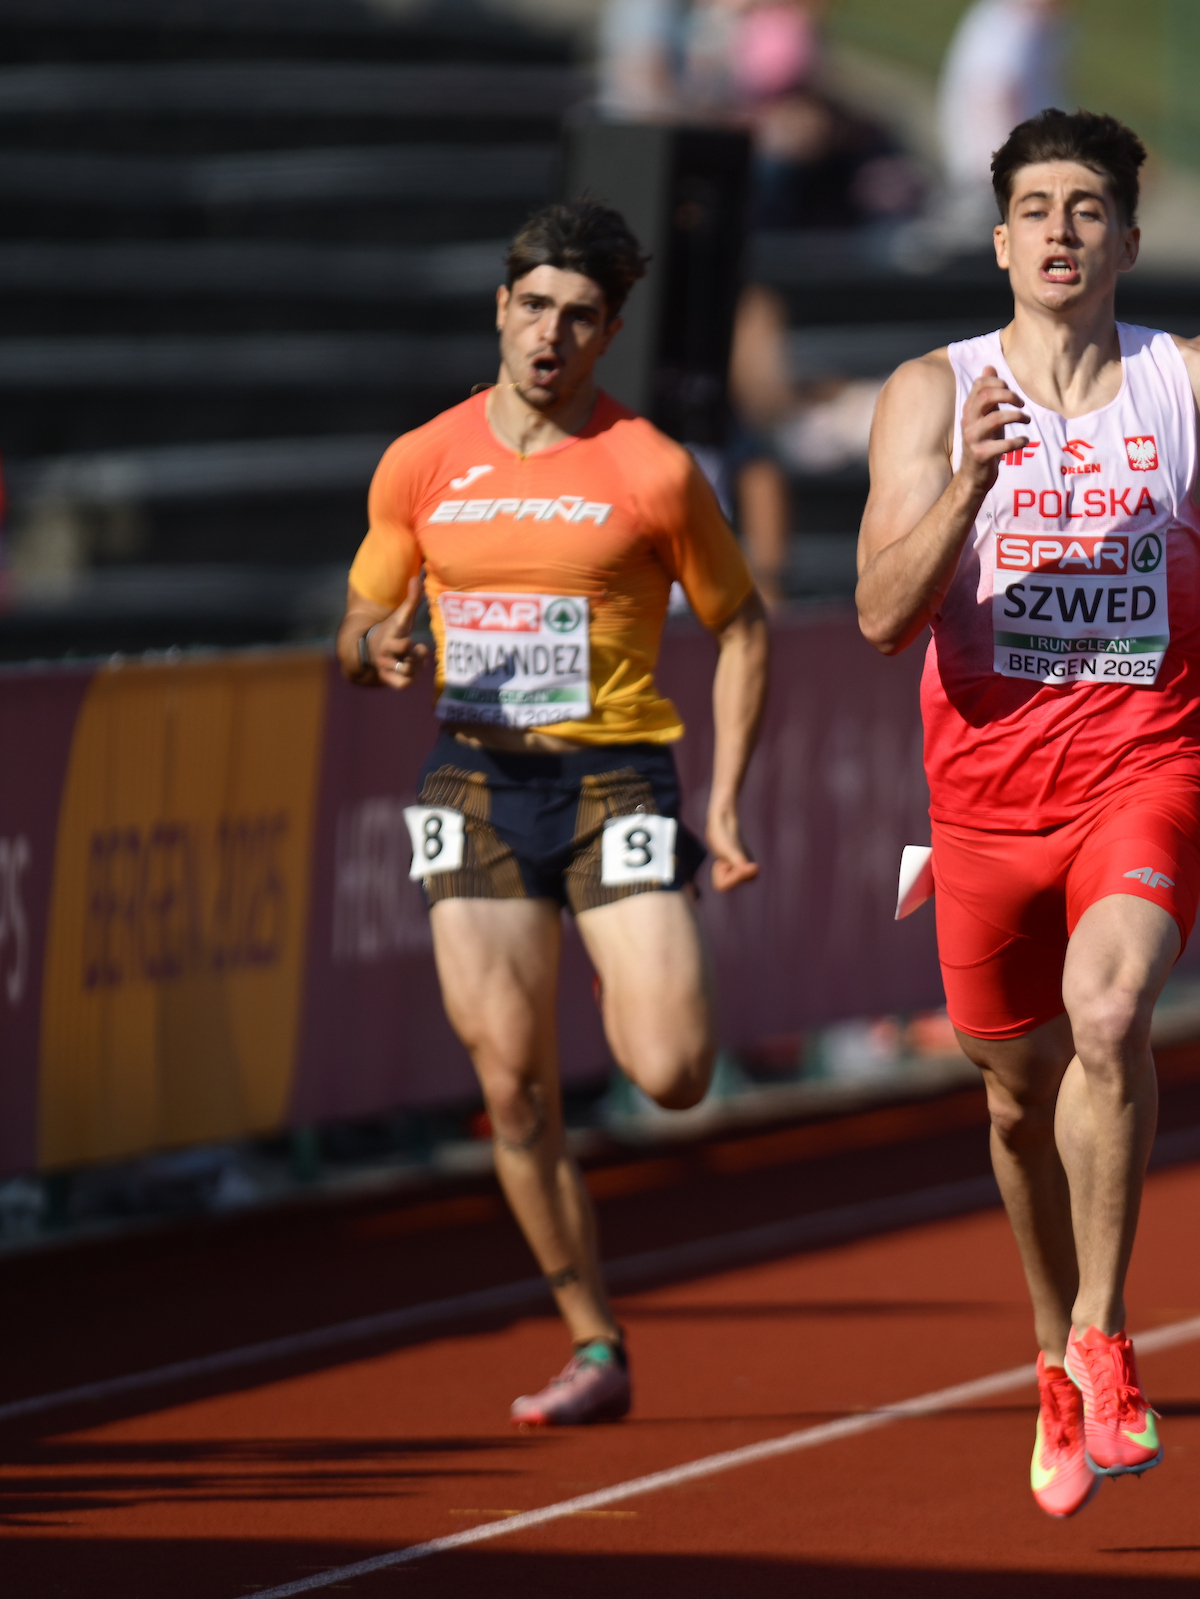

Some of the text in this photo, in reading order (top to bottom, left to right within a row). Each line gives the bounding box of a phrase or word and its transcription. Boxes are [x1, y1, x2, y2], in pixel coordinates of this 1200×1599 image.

[1060, 463, 1101, 475] ORLEN
[428, 495, 613, 526] ESPAÑA
[1013, 487, 1157, 518] POLSKA
[1000, 538, 1125, 569] SPAR
[444, 601, 538, 629] SPAR
[1003, 583, 1156, 623] SZWED
[448, 642, 582, 676] FERNANDEZ
[1038, 638, 1071, 652] RUN
[1009, 653, 1156, 677] BERGEN 2025
[425, 815, 443, 860] 8
[625, 827, 652, 867] 8
